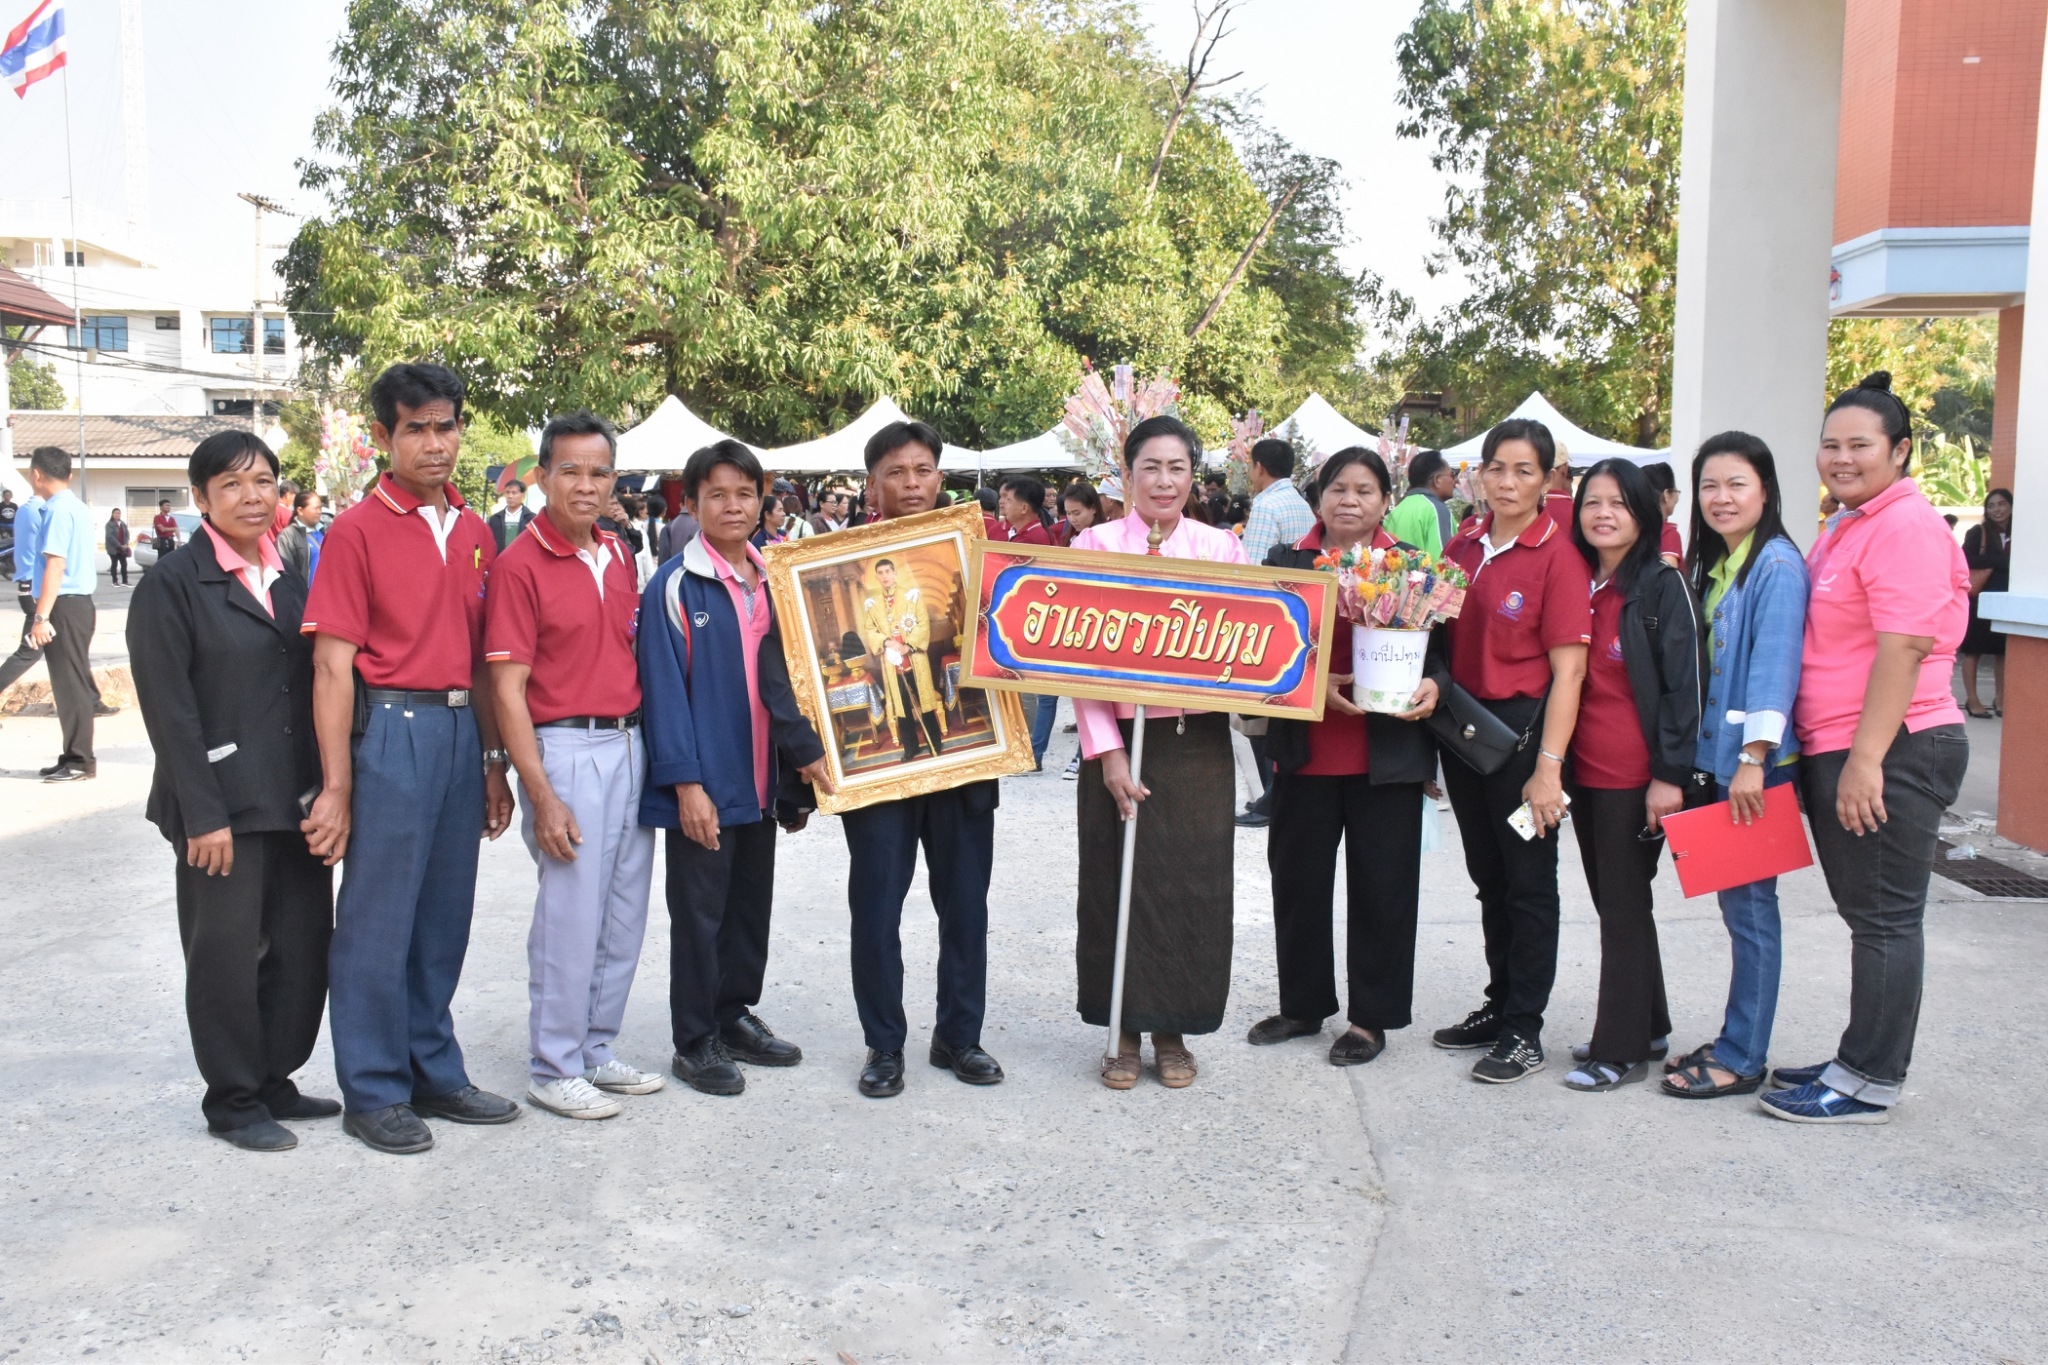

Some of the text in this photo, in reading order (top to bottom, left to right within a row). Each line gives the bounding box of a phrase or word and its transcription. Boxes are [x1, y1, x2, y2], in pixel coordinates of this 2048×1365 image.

[1023, 582, 1274, 684] อำเภอวาปีปทุม
